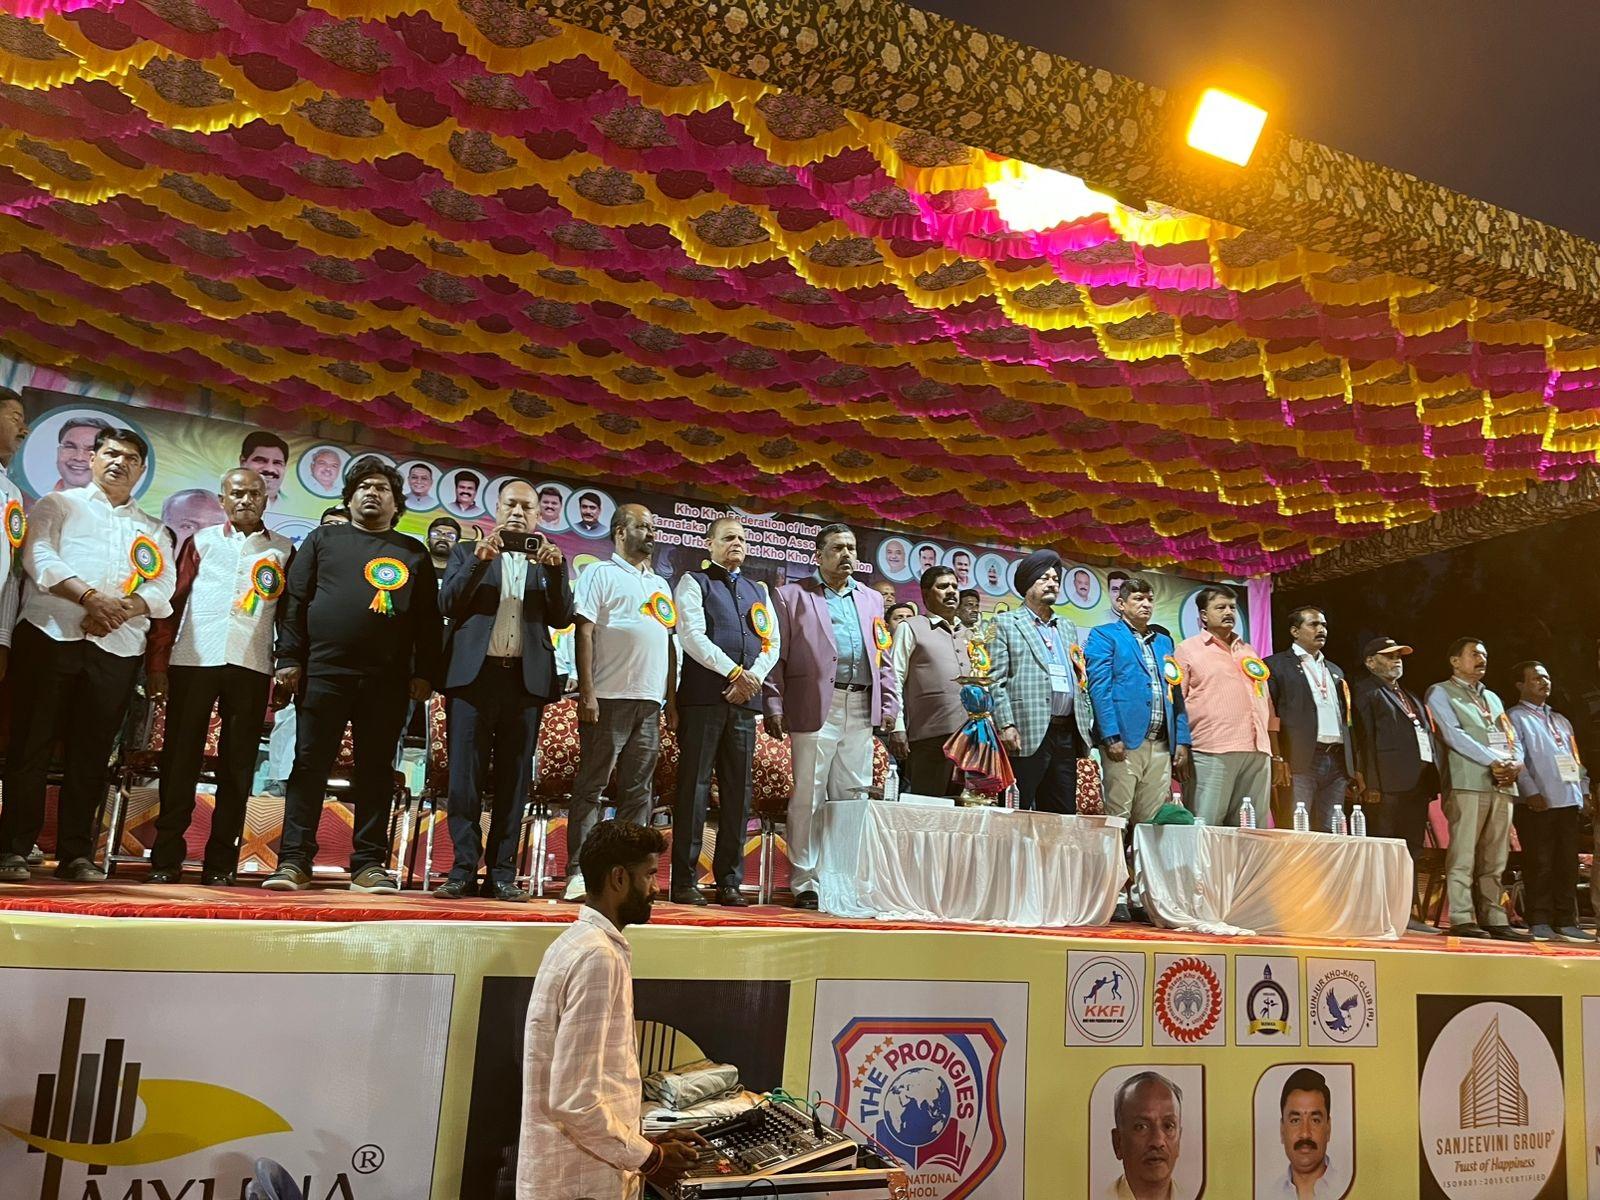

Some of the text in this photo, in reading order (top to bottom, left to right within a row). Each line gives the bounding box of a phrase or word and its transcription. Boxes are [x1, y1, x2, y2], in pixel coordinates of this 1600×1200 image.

[675, 503, 700, 517] Kho
[702, 507, 726, 520] Kho
[787, 524, 800, 534] of
[801, 524, 823, 537] Indi
[763, 530, 788, 546] Kho
[654, 530, 680, 545] alore
[682, 534, 710, 549] Urba
[761, 545, 786, 559] Kho
[786, 551, 809, 565] Kho
[1310, 978, 1326, 1018] GUNJUR
[1324, 969, 1360, 983] KHO-KHO
[1359, 980, 1374, 1006] CLUB
[1084, 1005, 1126, 1018] KKFI
[860, 1039, 975, 1123] THE PRODIGIES
[1436, 1134, 1509, 1155] SANJEEVINI
[1454, 1156, 1536, 1173] Trust of Happiness
[907, 1173, 959, 1184] NATIONAL
[1504, 1173, 1547, 1184] CERTIFIED
[909, 1186, 938, 1198] HOOL
